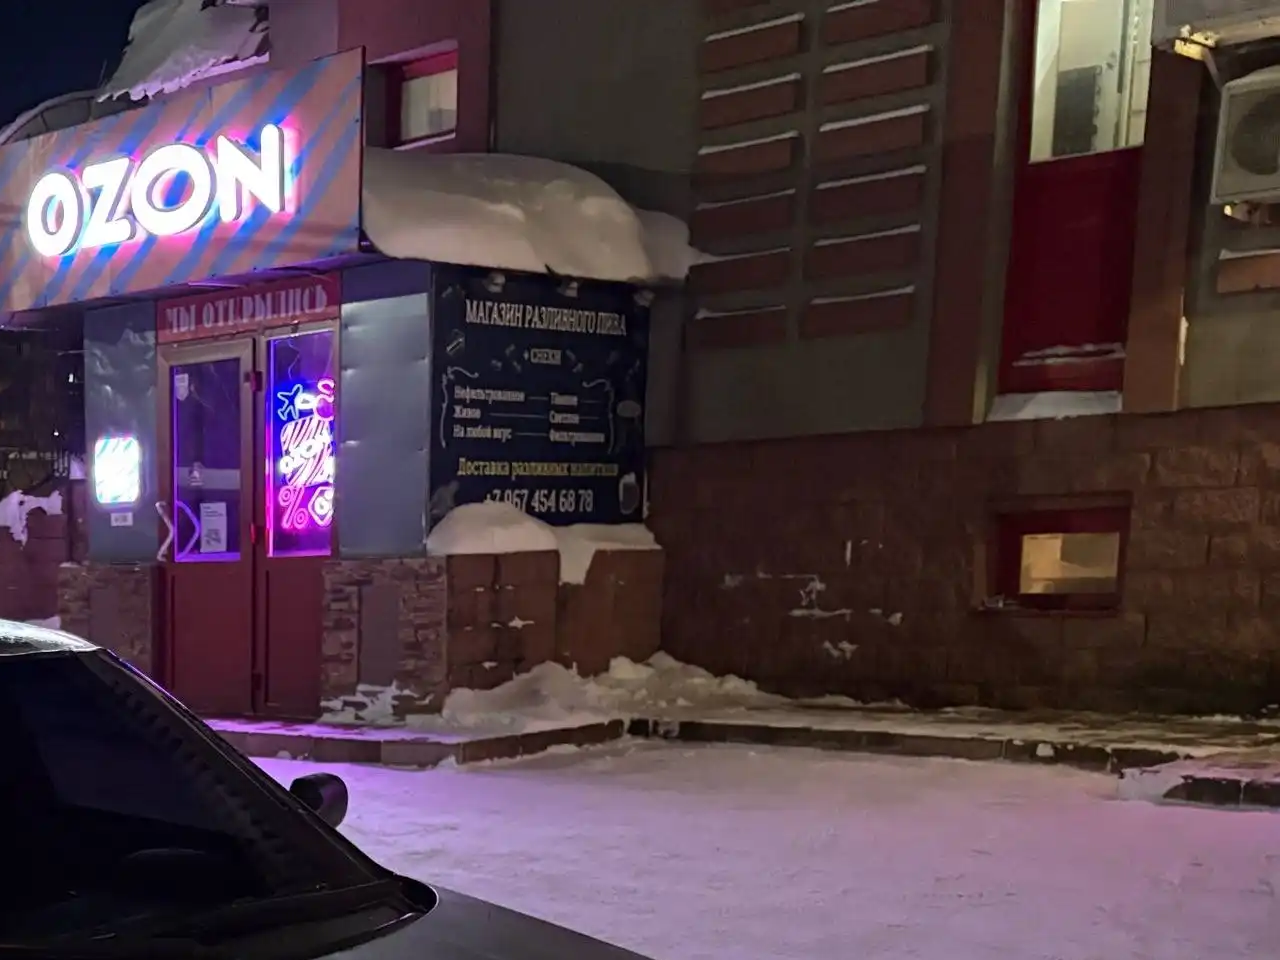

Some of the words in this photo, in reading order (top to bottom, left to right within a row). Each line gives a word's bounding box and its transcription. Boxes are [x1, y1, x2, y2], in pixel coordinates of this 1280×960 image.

[27, 123, 285, 257] OZON
[465, 298, 523, 327] МАГАЗИН
[524, 304, 596, 334] РАЗЛИВНОГО
[457, 457, 510, 476] Доставка
[531, 489, 556, 512] 454
[559, 489, 576, 512] 68
[578, 489, 594, 512] 78
